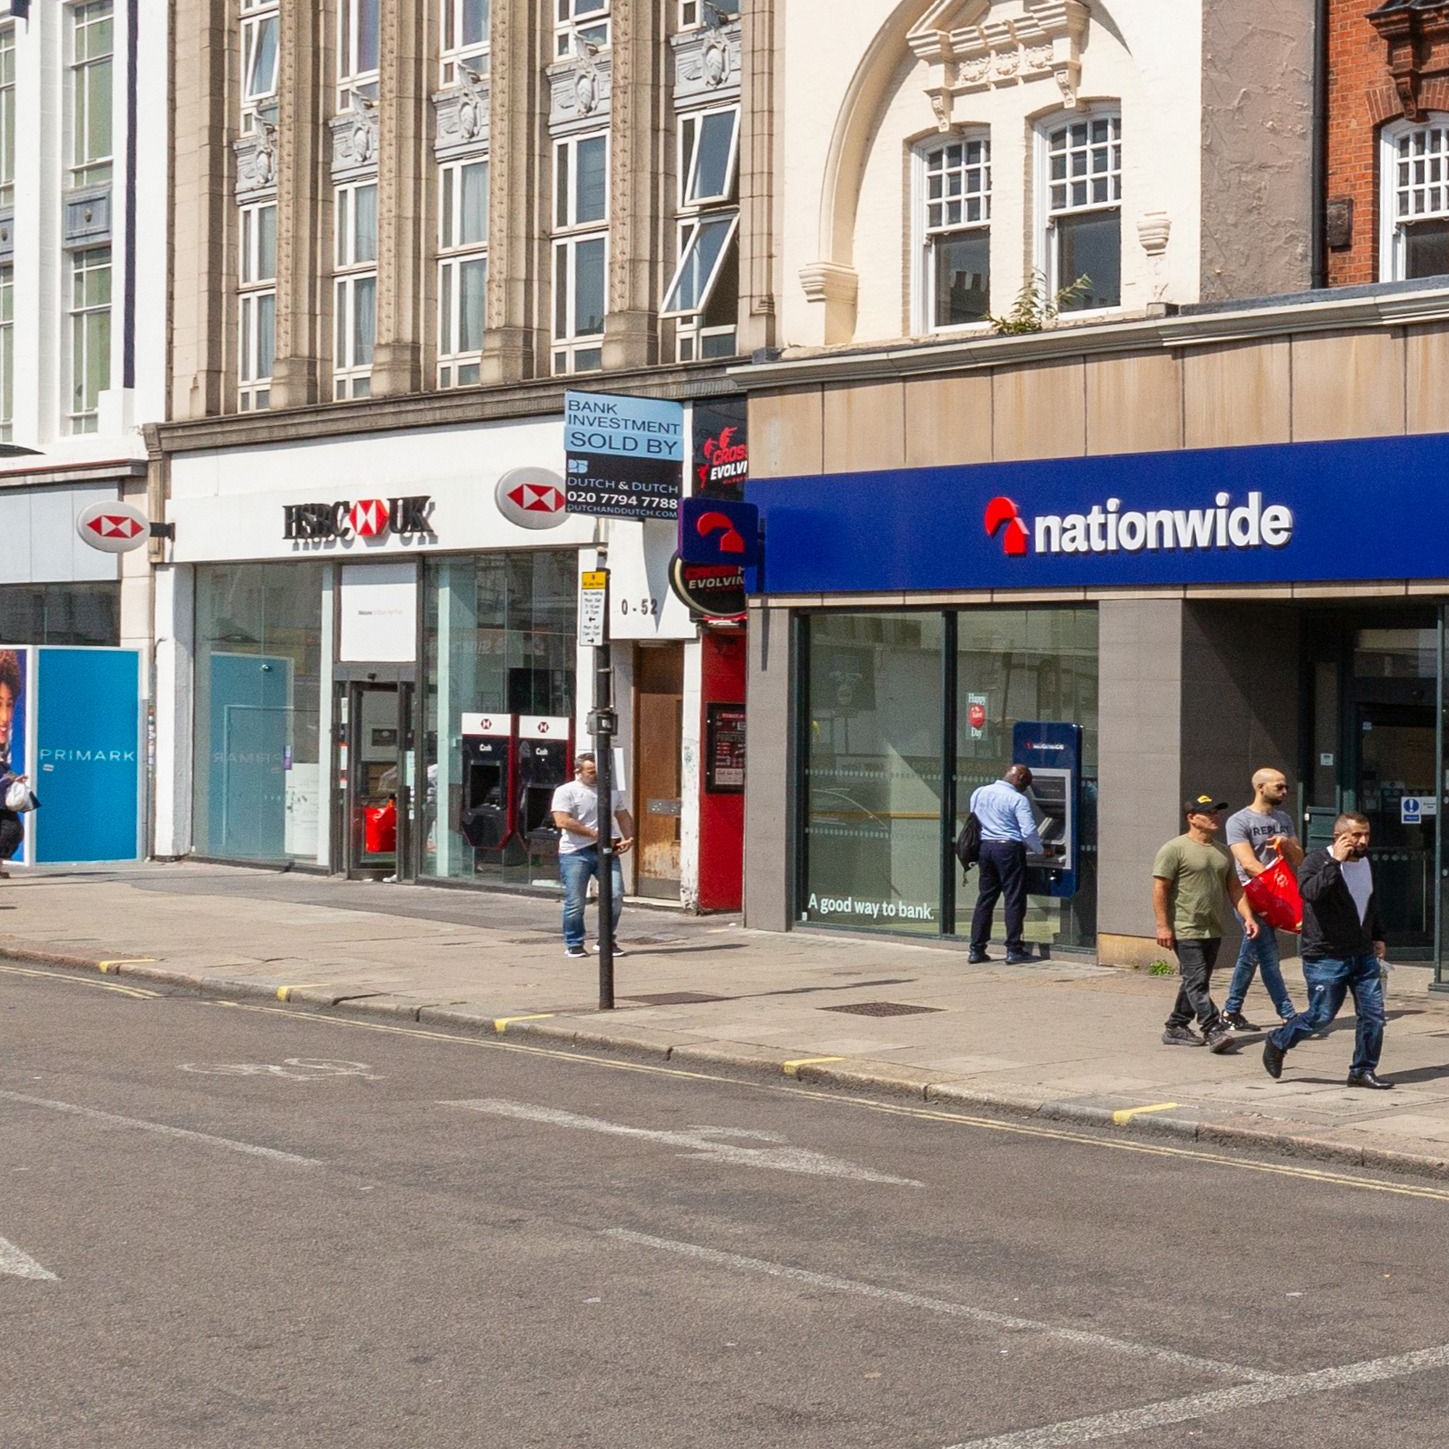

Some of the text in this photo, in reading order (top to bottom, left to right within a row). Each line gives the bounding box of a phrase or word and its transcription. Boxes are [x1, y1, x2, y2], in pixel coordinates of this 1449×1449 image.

[567, 399, 618, 415] BANK
[568, 414, 681, 435] INVESTMENT
[570, 431, 678, 455] SOLD BY
[567, 477, 678, 494] DUTCH & DUTCH
[567, 491, 678, 509] 020 7794 7788
[282, 495, 434, 540] HSBC UK
[567, 503, 678, 518] DUTCHANDDUTCH.COM
[1034, 491, 1294, 554] nationwide
[641, 598, 658, 616] 52
[39, 748, 135, 762] PRIMARK
[1252, 825, 1289, 837] REPLAY
[808, 893, 935, 920] A good way to bank.
